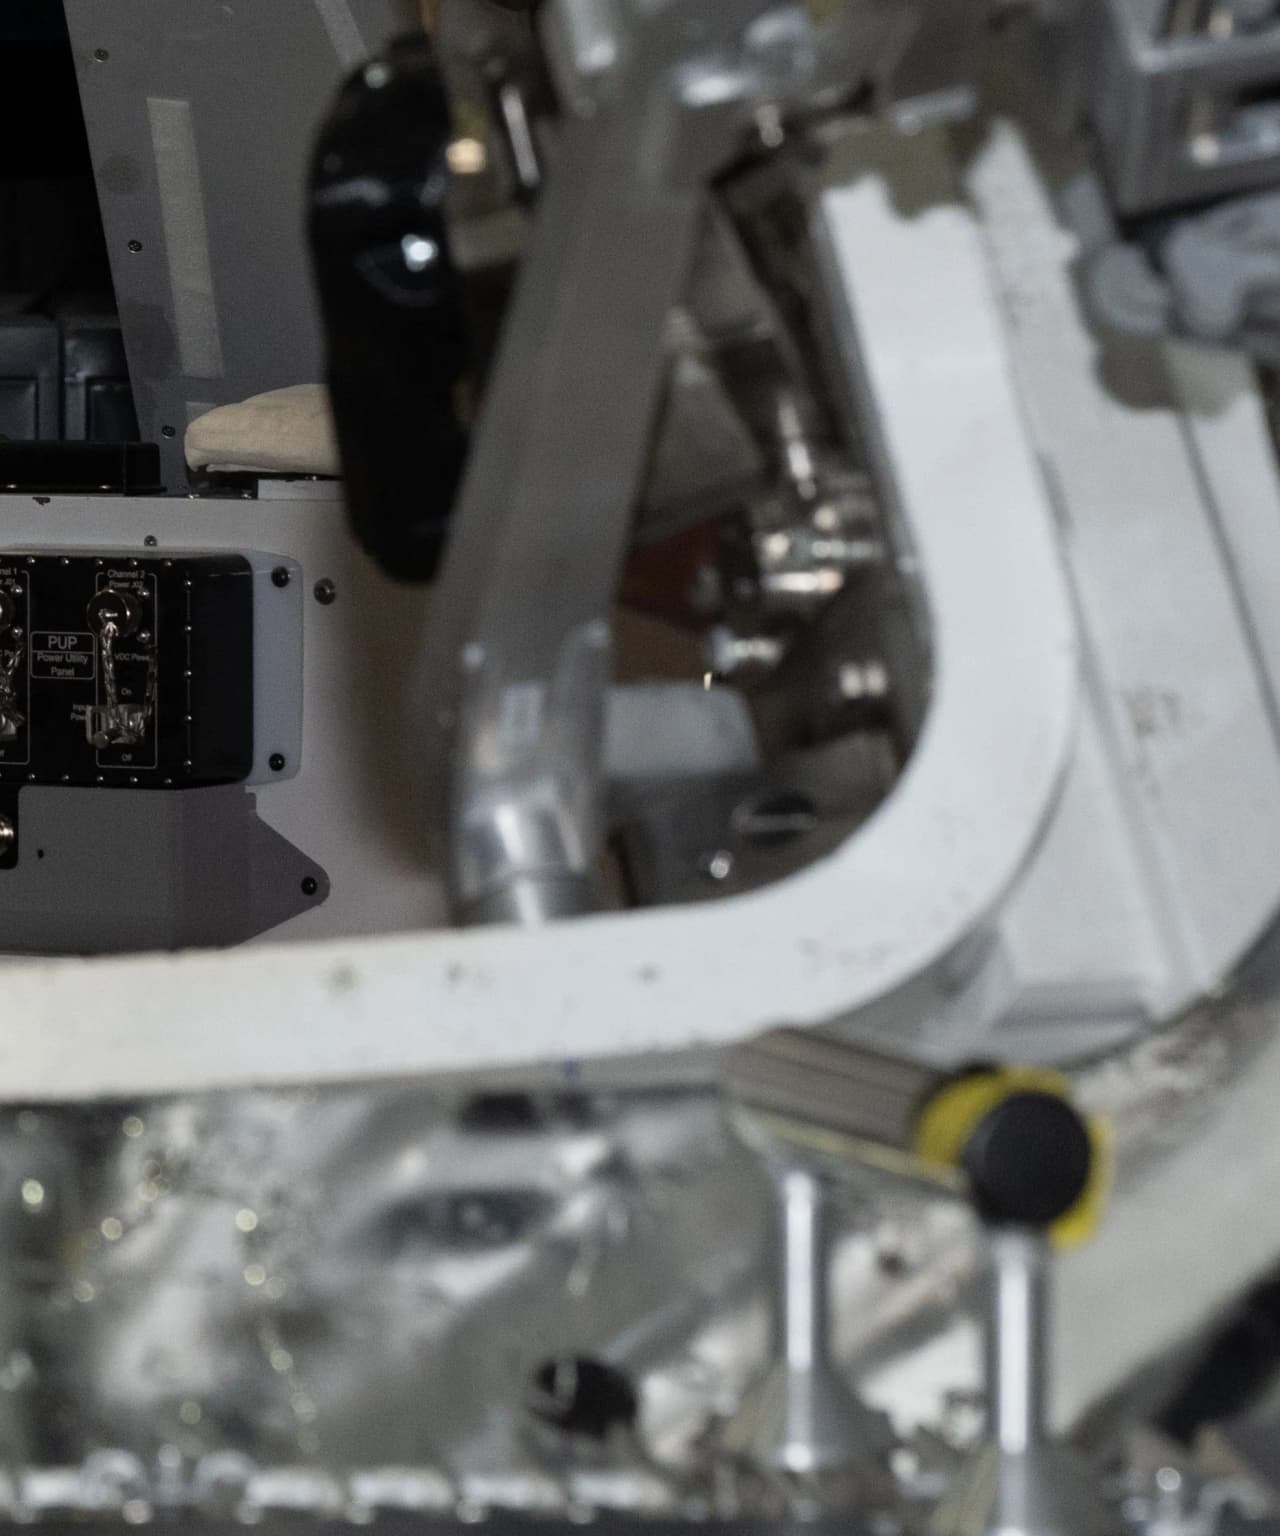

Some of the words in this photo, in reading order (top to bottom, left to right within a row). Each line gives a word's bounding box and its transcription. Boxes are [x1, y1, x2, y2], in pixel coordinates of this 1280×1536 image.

[107, 569, 138, 579] Channel
[108, 580, 130, 589] Power
[48, 635, 78, 650] PUP
[37, 652, 63, 662] Power
[65, 653, 88, 665] Utility
[51, 666, 75, 676] Panel
[121, 687, 132, 695] On
